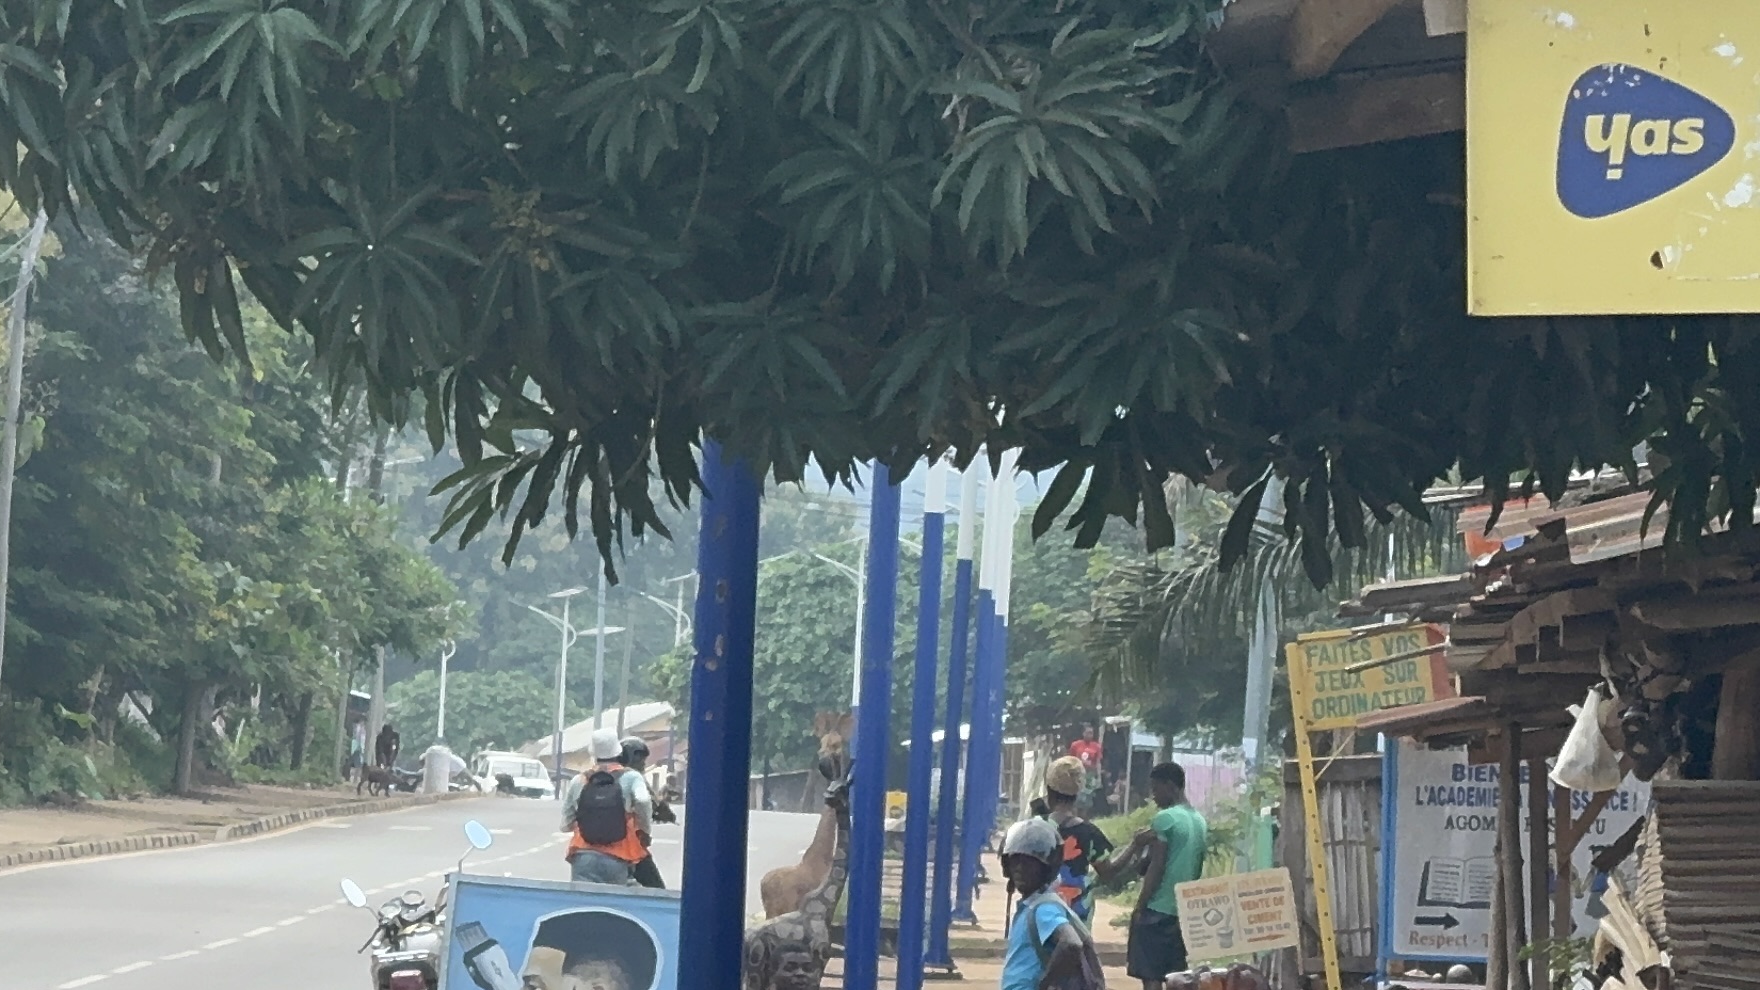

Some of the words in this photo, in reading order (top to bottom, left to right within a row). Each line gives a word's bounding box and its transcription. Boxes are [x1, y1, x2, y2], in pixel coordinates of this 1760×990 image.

[1584, 113, 1705, 180] yas
[1305, 638, 1372, 668] FAITES
[1380, 633, 1420, 656] VOS
[1314, 668, 1365, 693] JEUX
[1382, 660, 1419, 685] SUR
[1312, 686, 1426, 720] ORDINATEUR
[1409, 930, 1468, 949] Respect
